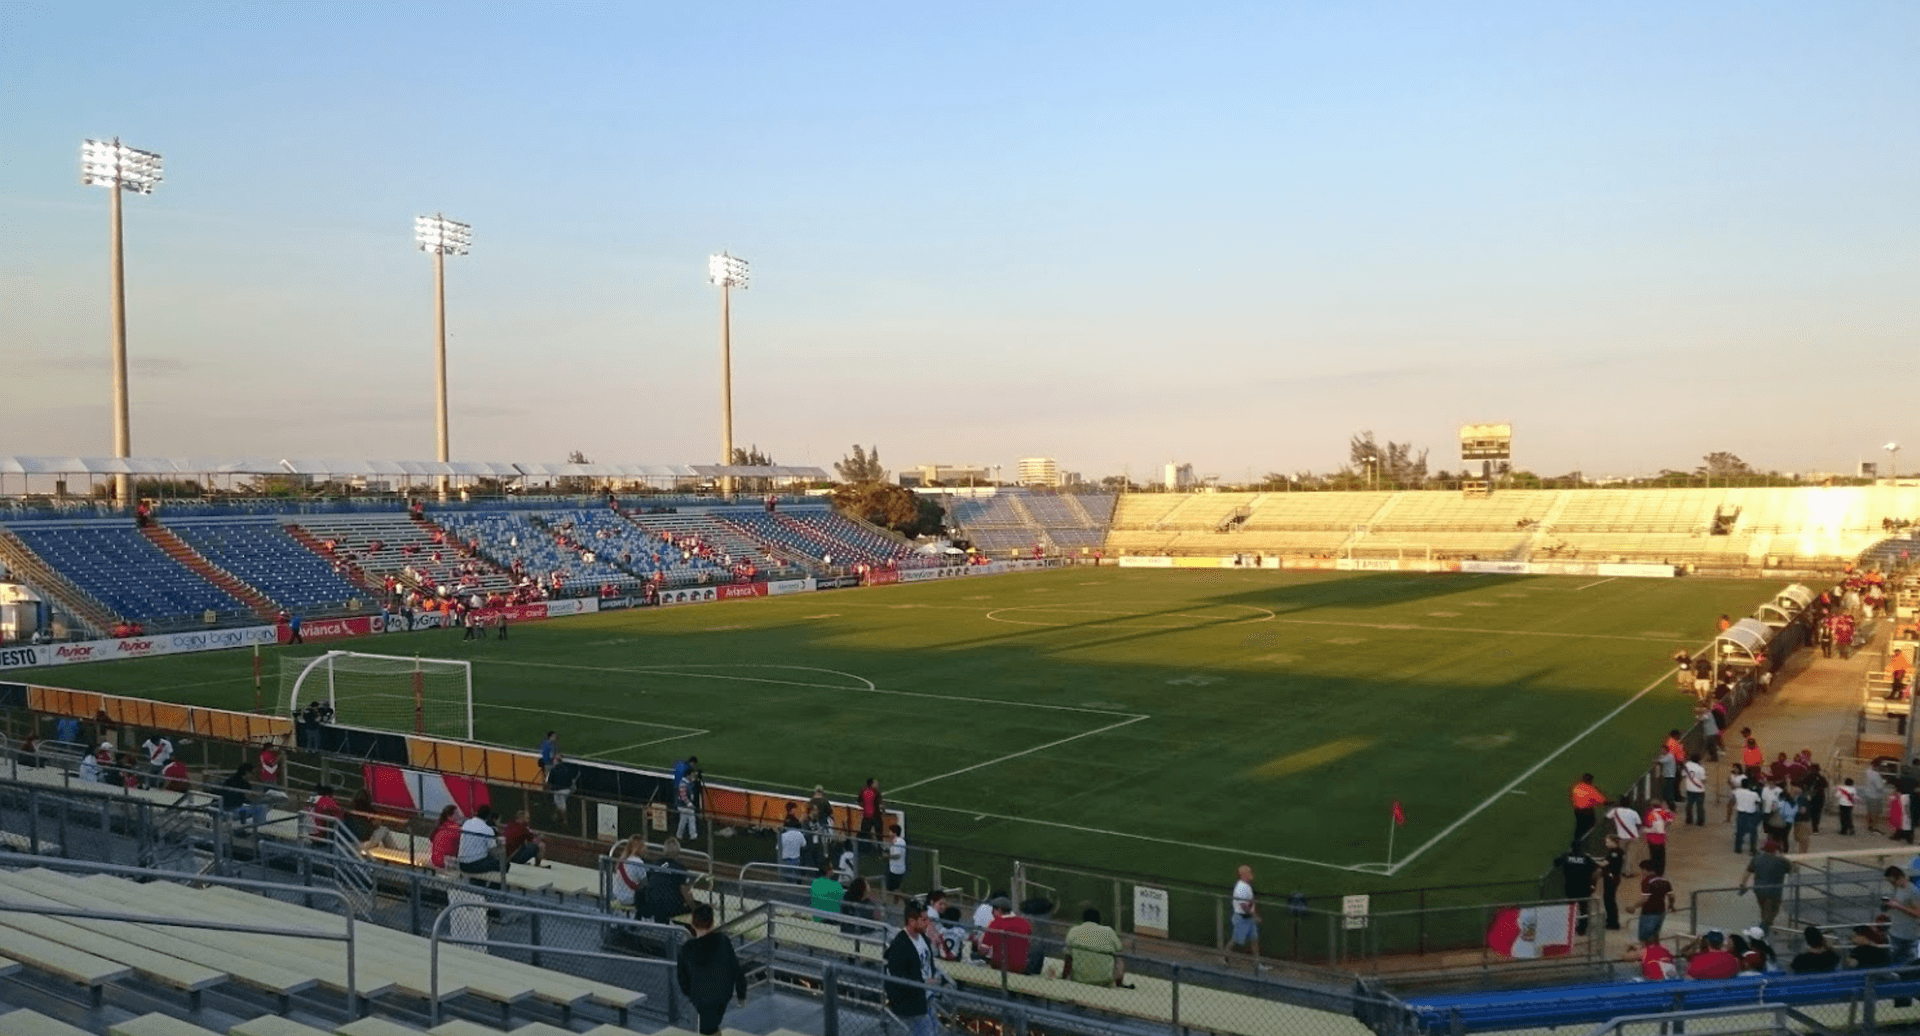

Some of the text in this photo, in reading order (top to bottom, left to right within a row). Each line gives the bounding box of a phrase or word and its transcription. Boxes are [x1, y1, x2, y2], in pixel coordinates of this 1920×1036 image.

[0, 648, 37, 666] ESTO
[56, 638, 154, 658] Avior Avior
